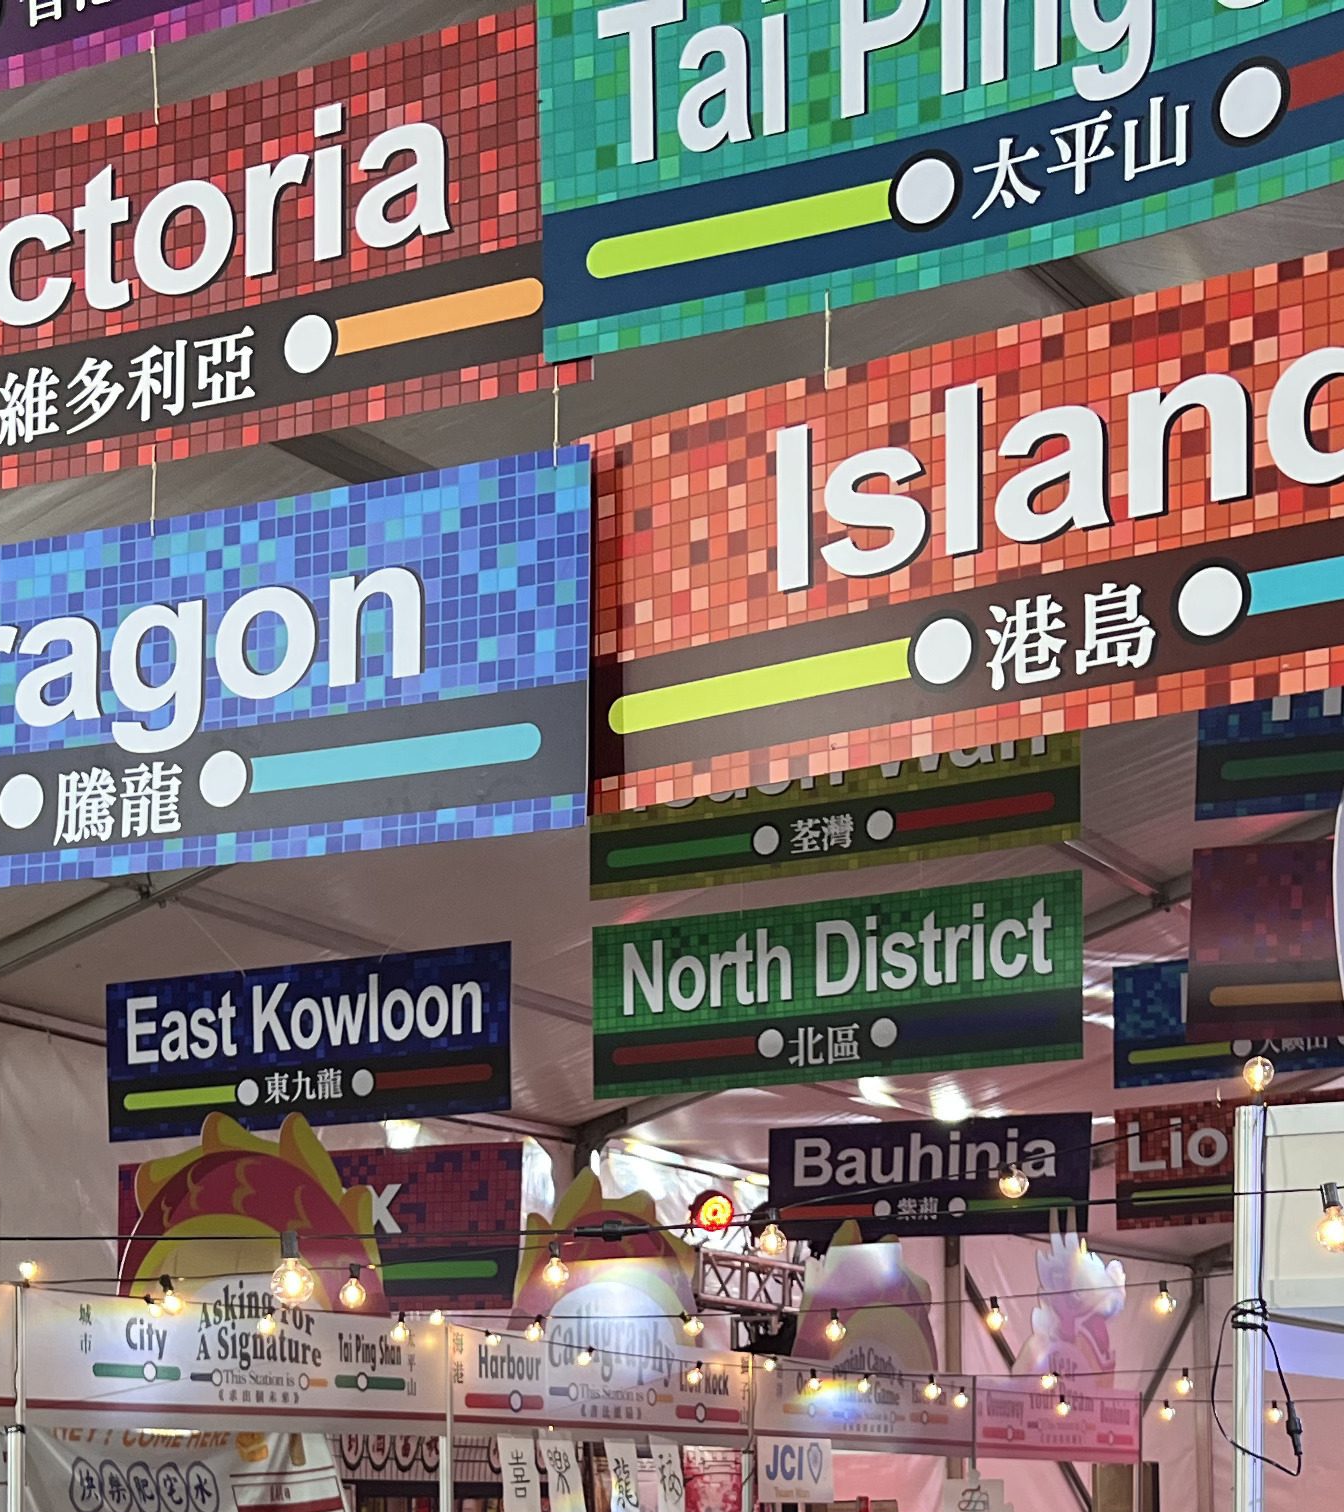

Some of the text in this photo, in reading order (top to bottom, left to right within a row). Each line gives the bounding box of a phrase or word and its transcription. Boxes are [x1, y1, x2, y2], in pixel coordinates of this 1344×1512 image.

[597, 0, 788, 164] Tai
[973, 96, 1189, 221] 太平山
[986, 581, 1154, 691] 港島
[789, 812, 855, 856] 荃灣
[622, 898, 1053, 1016] North District
[126, 973, 484, 1065] East Kowloon
[788, 1023, 861, 1067] 北區
[263, 1067, 344, 1105] 東九龍
[793, 1128, 1056, 1188] Bauhinia
[125, 1316, 168, 1360] City
[196, 1321, 322, 1371] A Signature
[338, 1332, 402, 1371] Tai Ping Shan
[548, 1298, 676, 1389] Calligraphy
[223, 1369, 296, 1387] This Station is
[478, 1343, 543, 1381] Harbour
[765, 1444, 804, 1481] JCI
